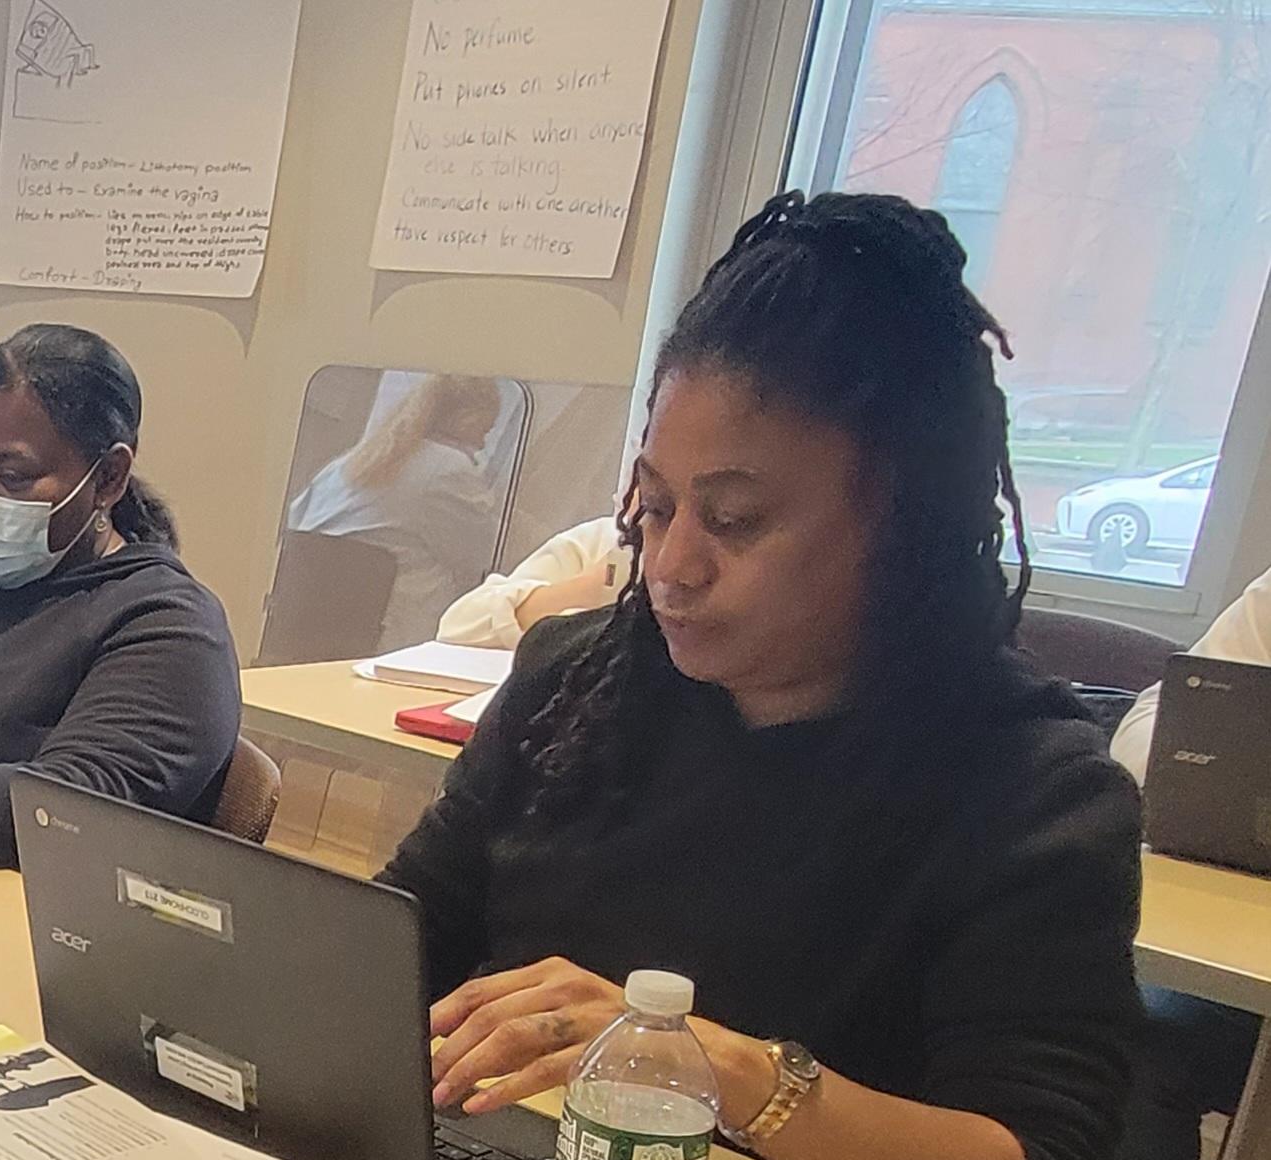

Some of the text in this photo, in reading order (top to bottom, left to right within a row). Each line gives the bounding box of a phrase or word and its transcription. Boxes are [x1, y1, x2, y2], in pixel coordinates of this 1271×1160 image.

[423, 16, 536, 57] No perfume
[413, 64, 612, 108] Put phones on silent
[403, 121, 432, 152] No
[532, 117, 578, 146] when
[19, 152, 60, 172] Name
[65, 151, 80, 170] of
[17, 176, 53, 198] Used
[56, 182, 74, 196] to
[93, 182, 144, 197] Examine
[150, 186, 170, 198] the
[174, 185, 219, 208] vagina
[497, 195, 528, 213] with
[536, 197, 565, 213] one
[15, 206, 40, 221] How
[394, 218, 429, 242] Have
[436, 229, 488, 250] respect
[18, 265, 77, 282] Comfort
[1173, 750, 1217, 766] acer
[50, 927, 92, 953] acer
